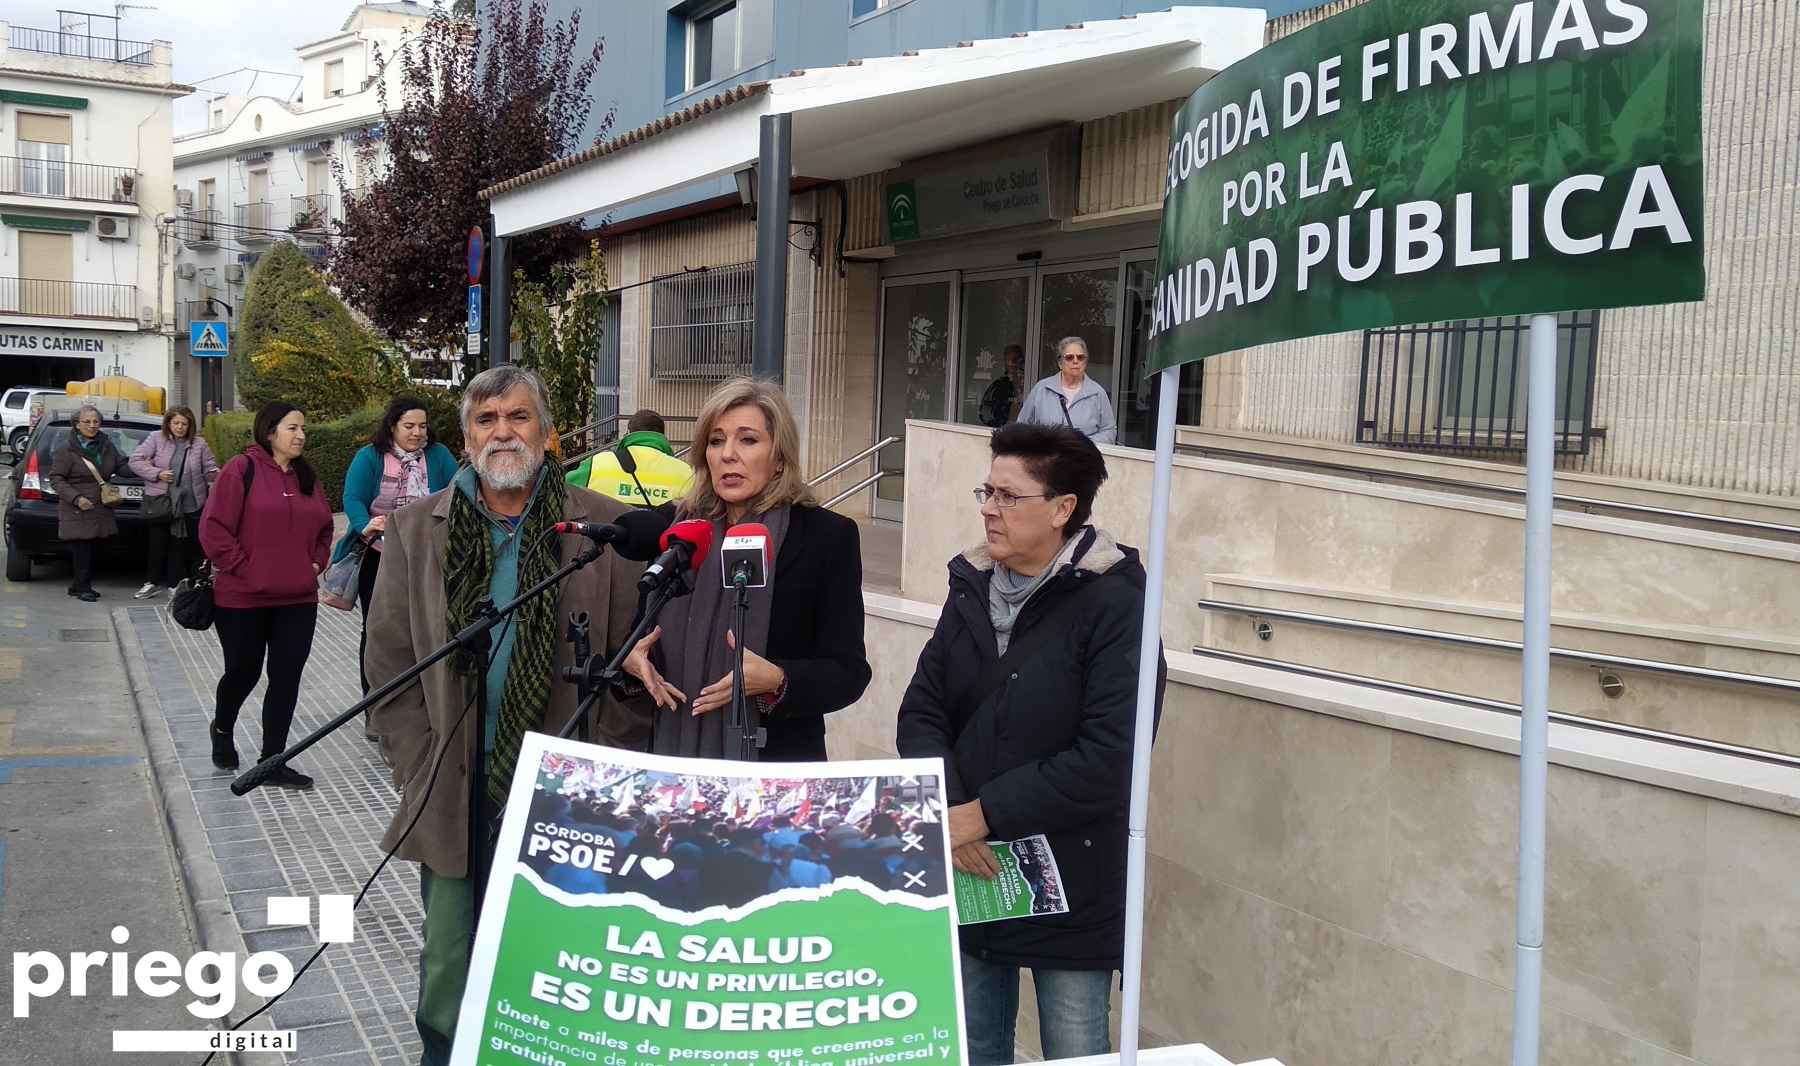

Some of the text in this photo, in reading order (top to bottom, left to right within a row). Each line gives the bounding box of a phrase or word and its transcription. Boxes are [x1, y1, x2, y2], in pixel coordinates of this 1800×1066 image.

[1282, 55, 1343, 129] DE
[1362, 0, 1648, 102] FIRMAS
[1009, 168, 1038, 190] Salud
[1222, 141, 1353, 226] POR LA
[1149, 164, 1692, 341] SANIDAD PÚBLICA
[42, 337, 104, 352] CARMEN
[634, 487, 669, 499] ONCE
[528, 834, 616, 874] PSOE
[534, 822, 615, 848] CÓRDOBA
[998, 871, 1013, 911] DERECHO
[1010, 868, 1022, 895] SALUD
[605, 925, 833, 965] LA SALUD
[557, 950, 885, 993] NO ES UN PRIVILEGIO,
[531, 971, 918, 1032] ES UN DERECHO
[494, 1018, 951, 1066] importancia de universal y
[497, 999, 949, 1062] Únete a miles de personas que creemos en la
